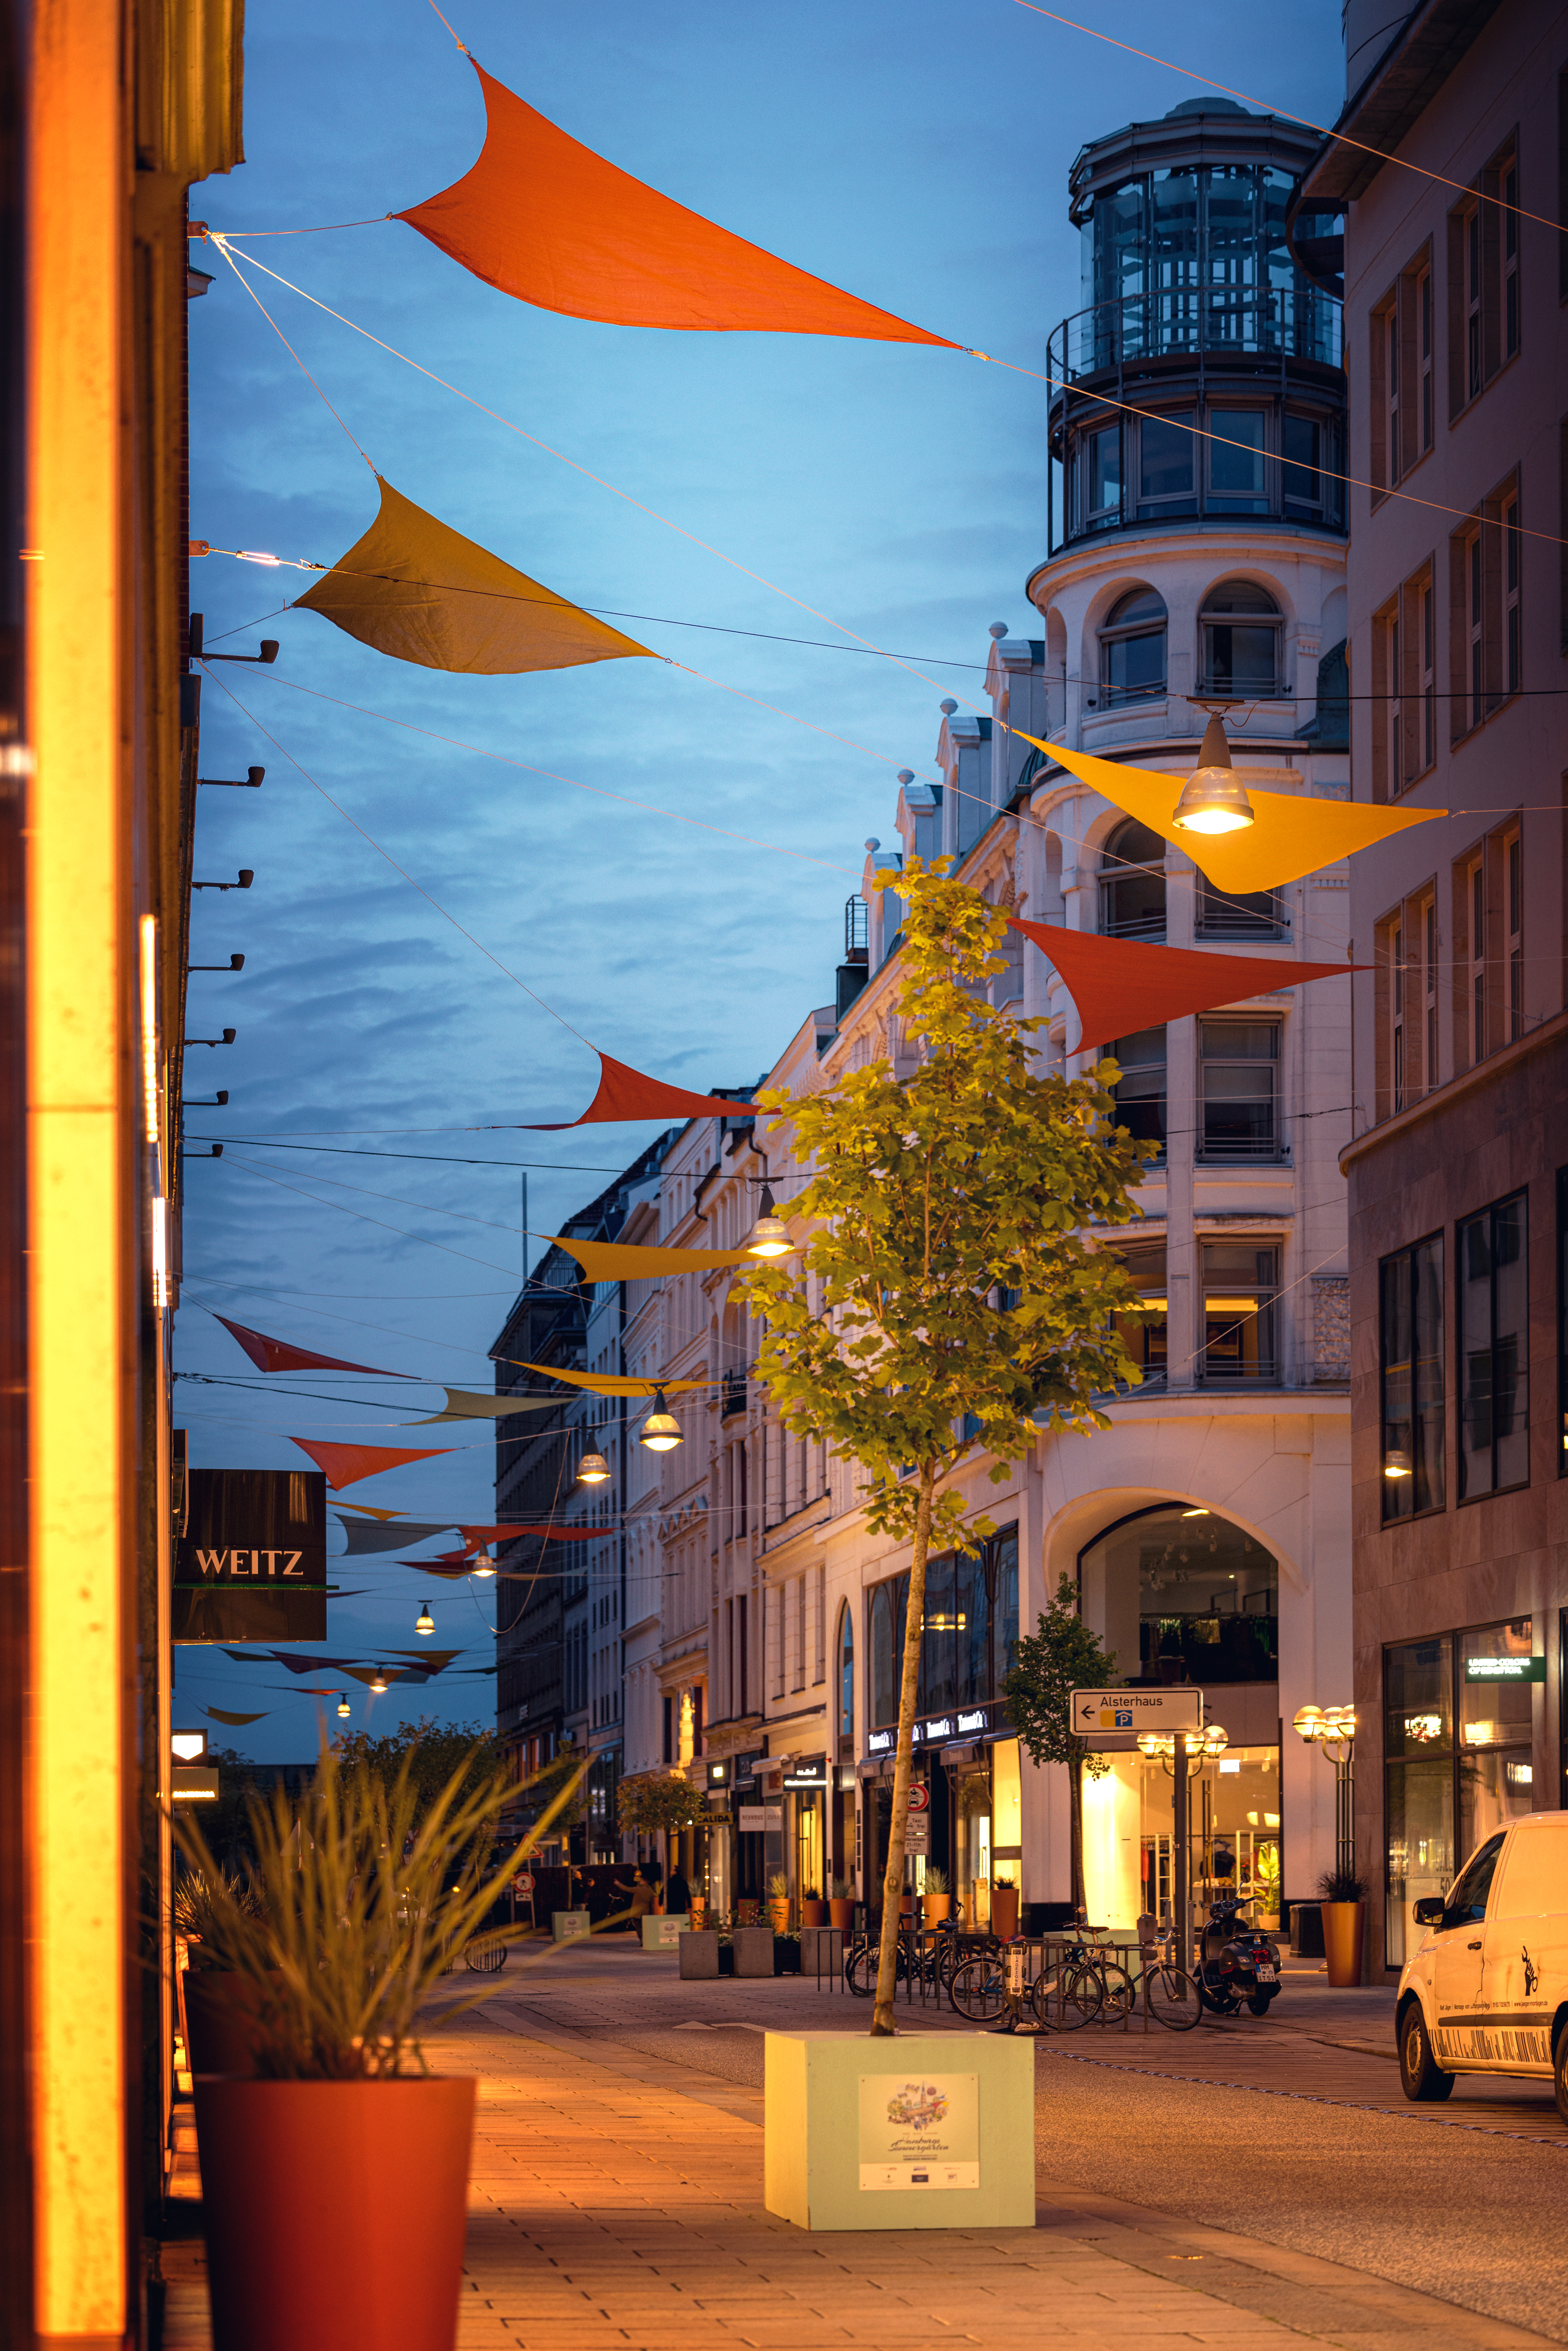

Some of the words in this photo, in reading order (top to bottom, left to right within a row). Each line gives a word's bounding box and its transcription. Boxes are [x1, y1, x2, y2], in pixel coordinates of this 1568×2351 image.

[196, 1550, 303, 1575] WEITZ
[1100, 1696, 1163, 1706] Alsterhaus
[1120, 1715, 1128, 1726] P
